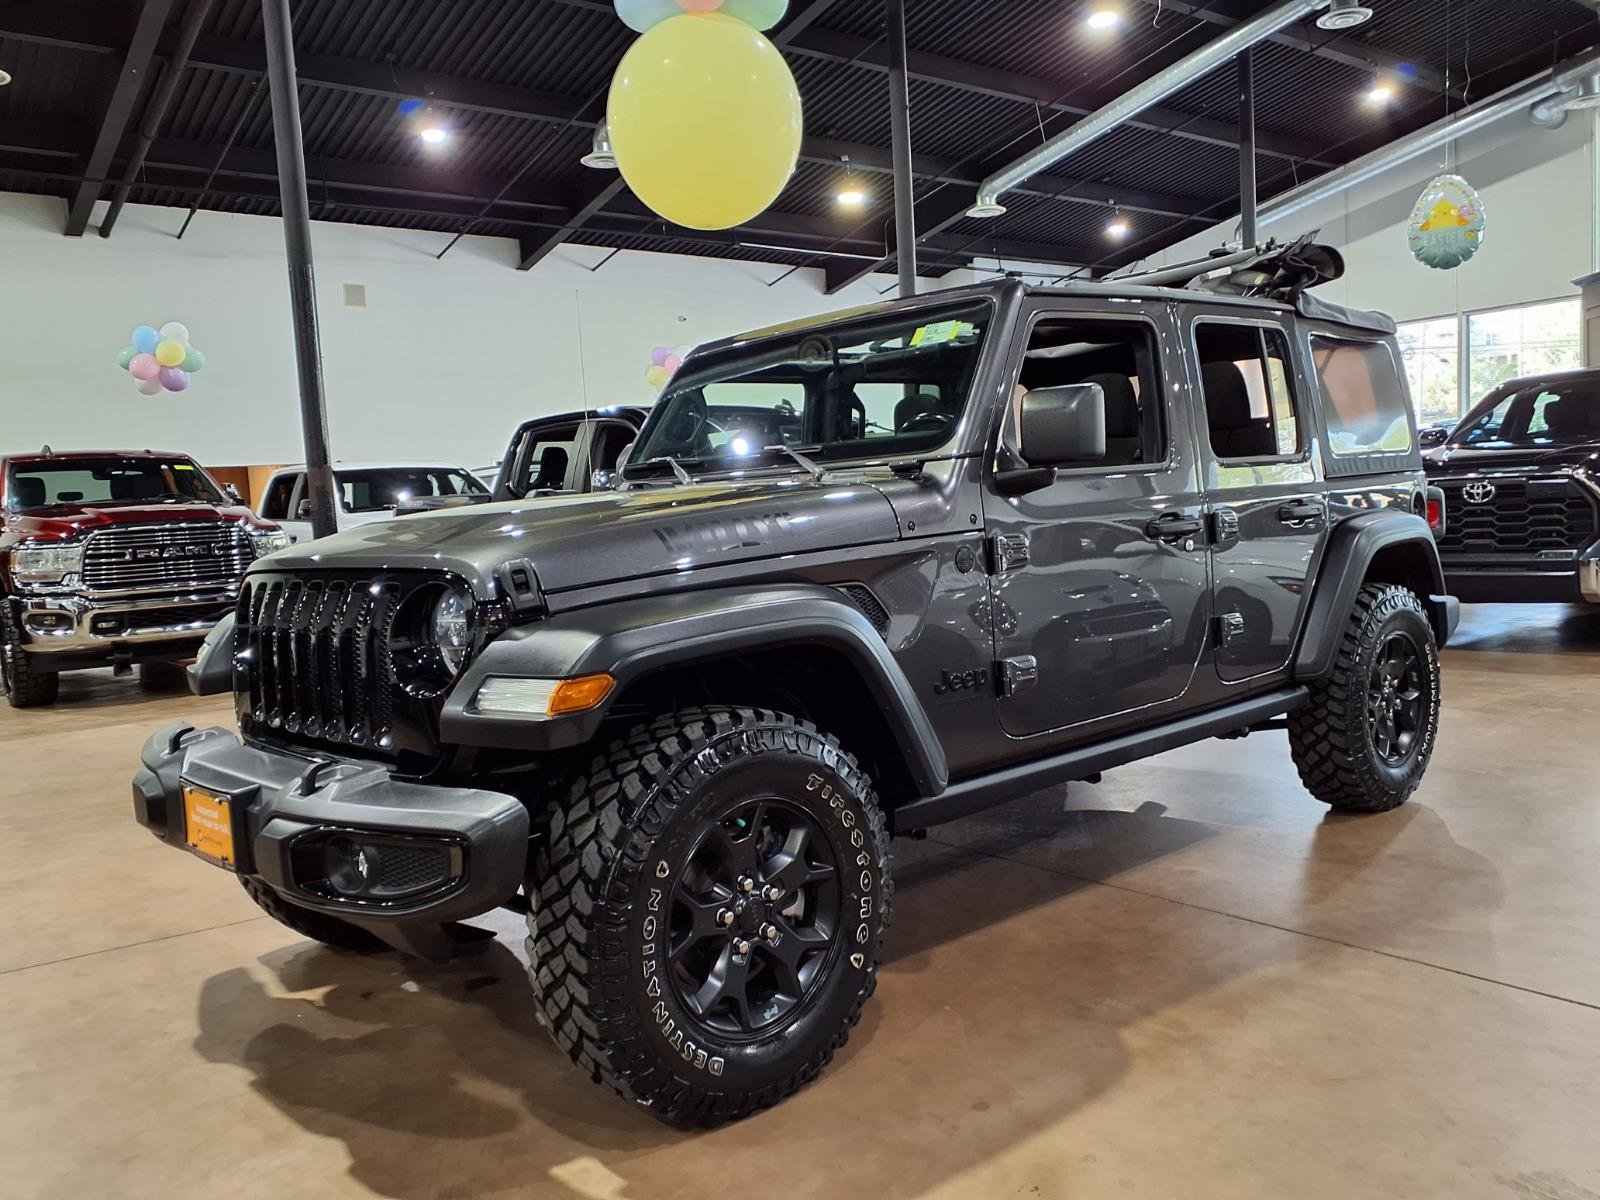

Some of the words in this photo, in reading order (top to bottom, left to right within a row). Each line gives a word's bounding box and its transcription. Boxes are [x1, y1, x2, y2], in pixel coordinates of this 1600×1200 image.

[136, 545, 208, 559] RAM
[934, 668, 987, 693] Jeep
[806, 773, 873, 945] Firestone
[642, 888, 725, 1077] DESTINATION
